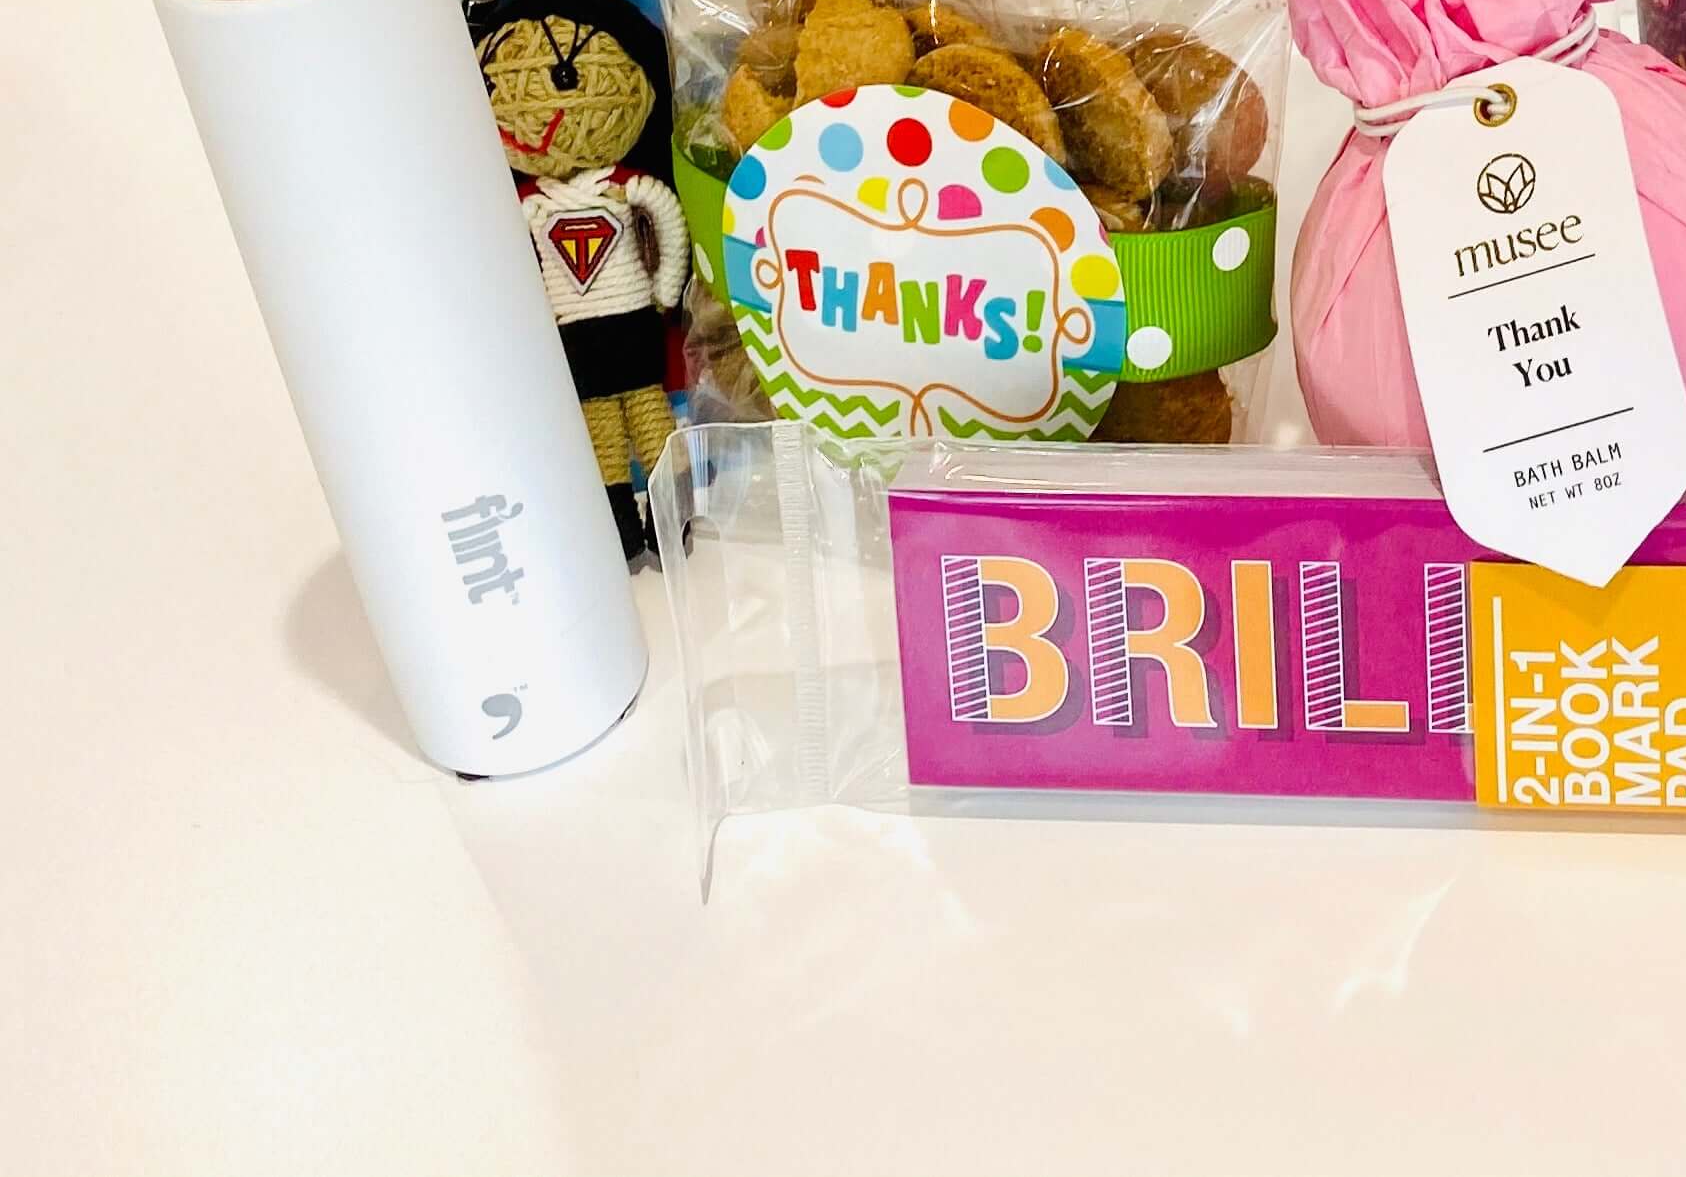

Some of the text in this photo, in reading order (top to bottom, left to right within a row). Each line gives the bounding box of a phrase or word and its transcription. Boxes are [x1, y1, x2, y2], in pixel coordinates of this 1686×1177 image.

[1453, 212, 1584, 278] musee
[784, 249, 1047, 361] THANKS!
[1486, 304, 1582, 353] Thank
[1511, 354, 1573, 389] You
[1513, 441, 1623, 489] BATH BALM
[1528, 490, 1557, 510] NET
[1564, 481, 1585, 501] WT
[1509, 649, 1561, 806] 2-IN-1
[1560, 638, 1612, 806] BOOK
[1612, 634, 1661, 808] MARK
